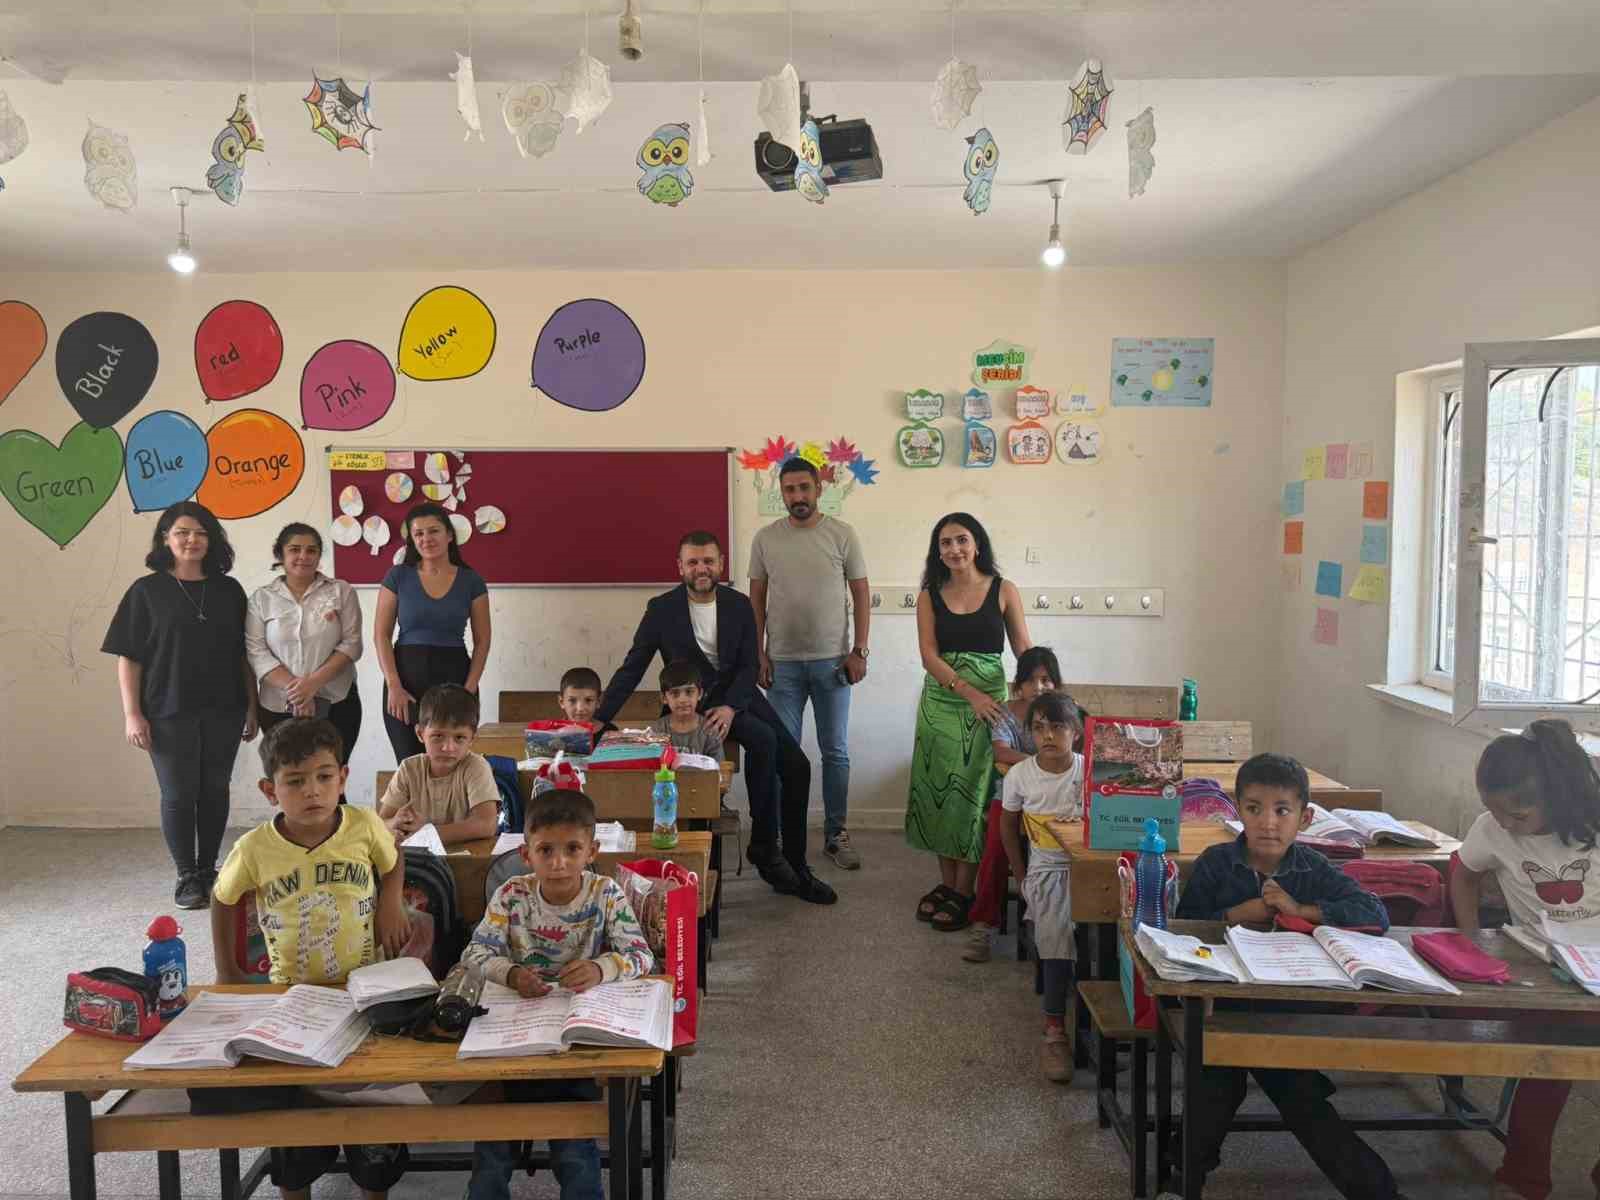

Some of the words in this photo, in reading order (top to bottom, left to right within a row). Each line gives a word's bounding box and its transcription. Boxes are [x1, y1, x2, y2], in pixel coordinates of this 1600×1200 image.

[210, 342, 240, 370] red
[413, 326, 457, 359] Yellow
[553, 328, 600, 354] Purple
[75, 344, 124, 398] Black
[315, 376, 367, 413] Pink
[134, 448, 184, 479] Blue
[215, 454, 290, 481] Orange
[17, 471, 95, 502] Green
[315, 862, 369, 890] DENIM
